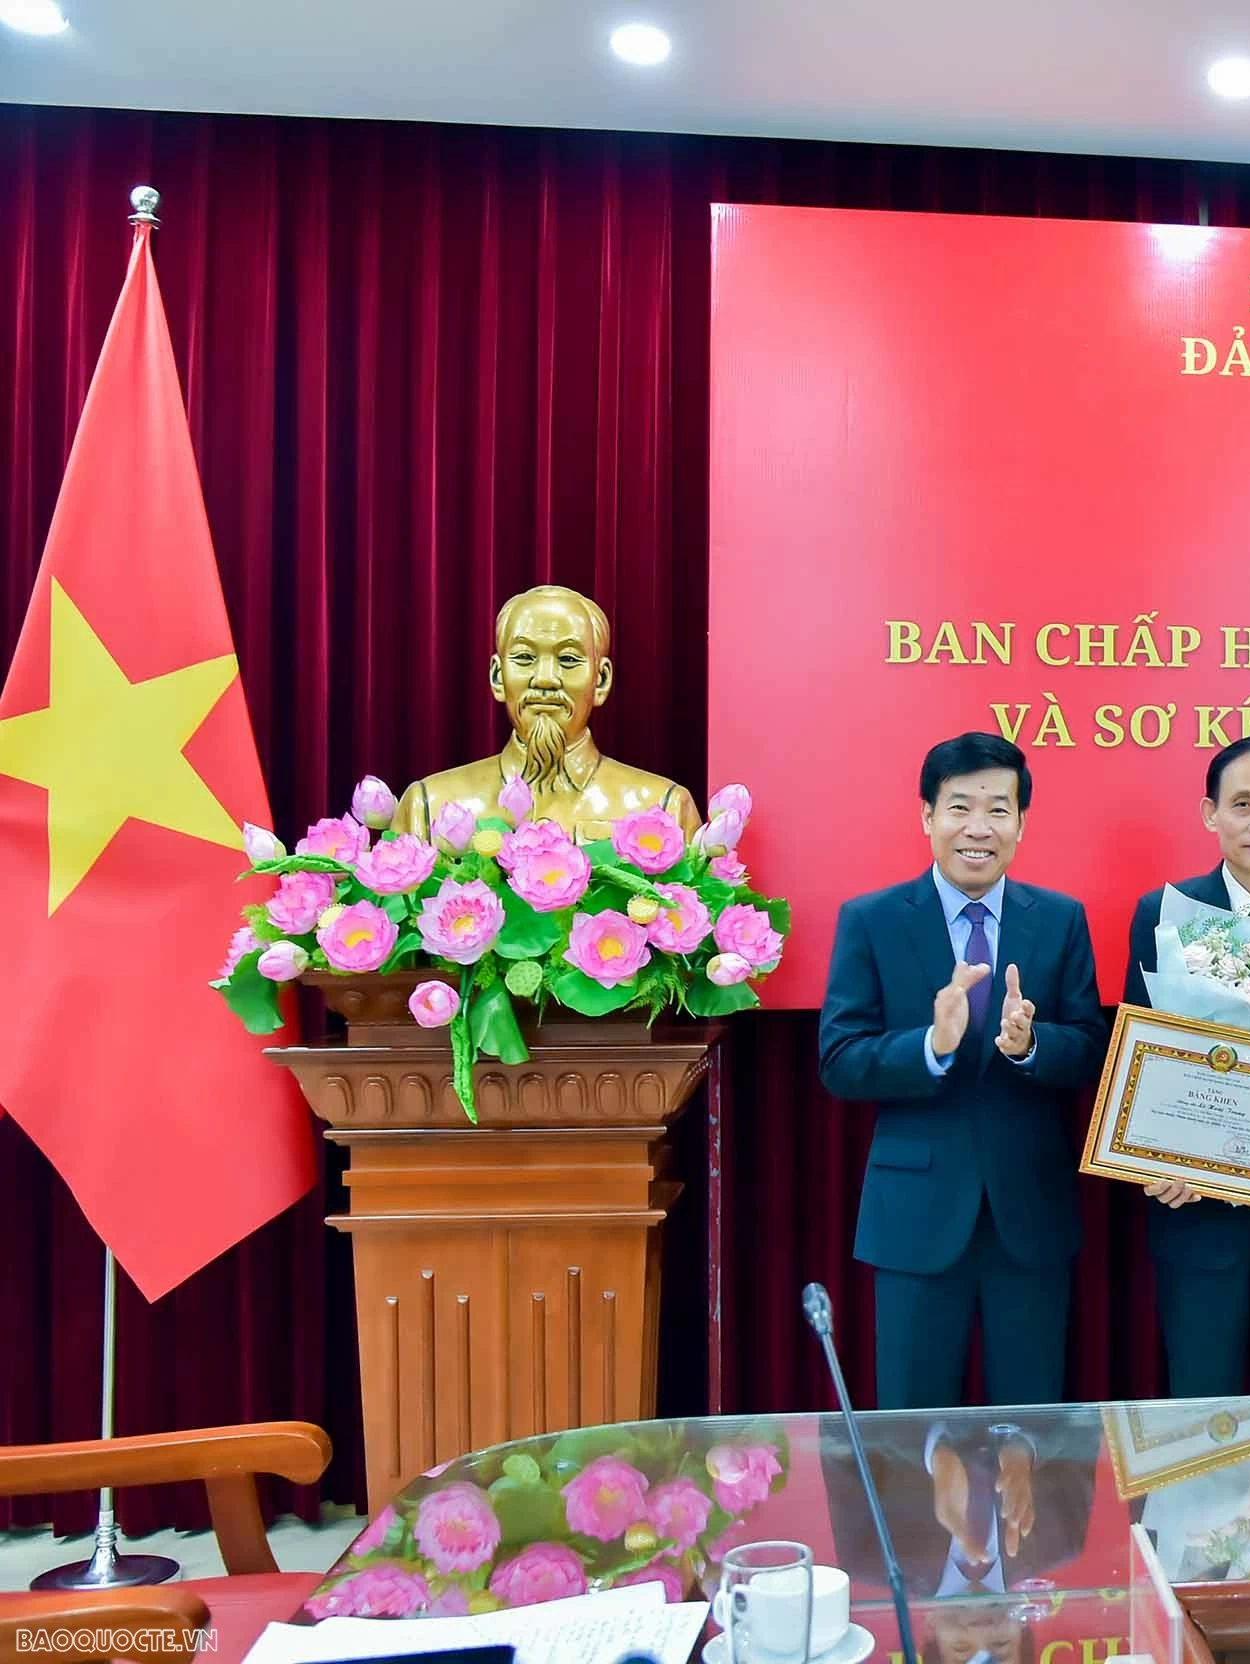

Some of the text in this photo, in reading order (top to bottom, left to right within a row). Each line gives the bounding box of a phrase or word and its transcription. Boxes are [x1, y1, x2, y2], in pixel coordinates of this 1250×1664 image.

[885, 620, 1014, 664] BAN
[1034, 611, 1201, 668] CHẤP
[989, 692, 1076, 747] VÀ
[1092, 703, 1177, 748] SƠ
